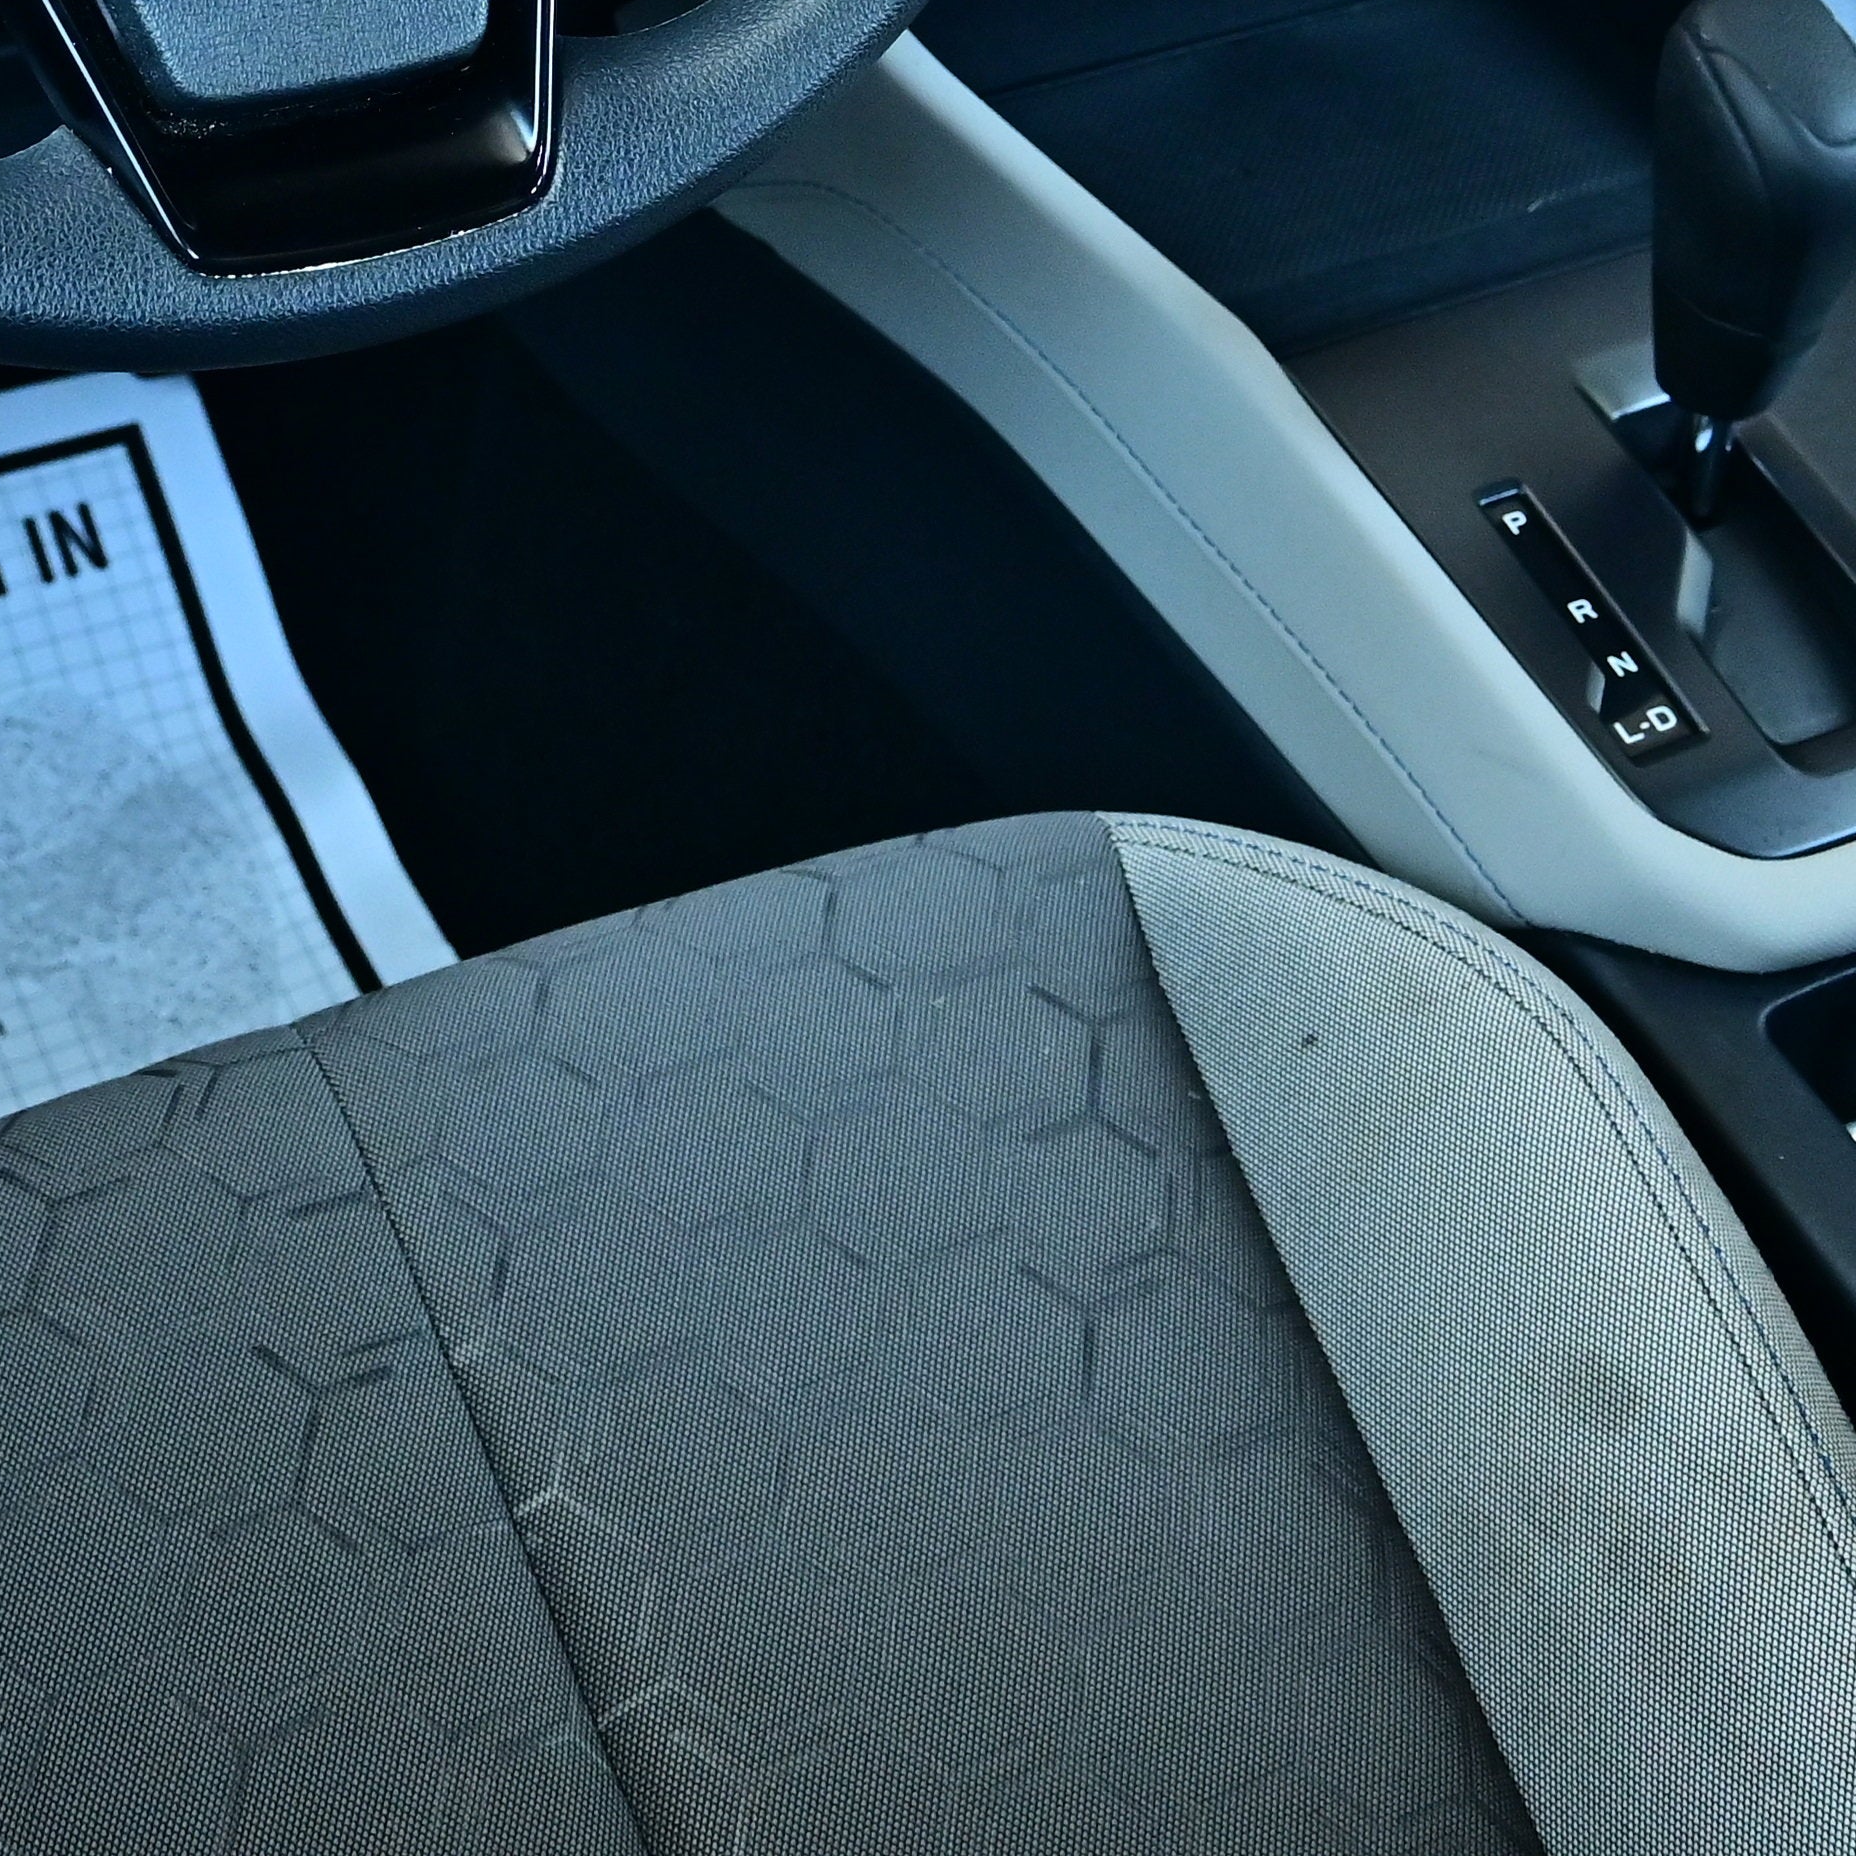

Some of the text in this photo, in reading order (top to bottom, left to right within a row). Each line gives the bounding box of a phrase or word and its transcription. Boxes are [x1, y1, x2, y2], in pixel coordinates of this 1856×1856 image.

[1502, 510, 1528, 535] P
[21, 501, 110, 585] IN
[1567, 598, 1598, 623] R
[1607, 650, 1639, 677] N
